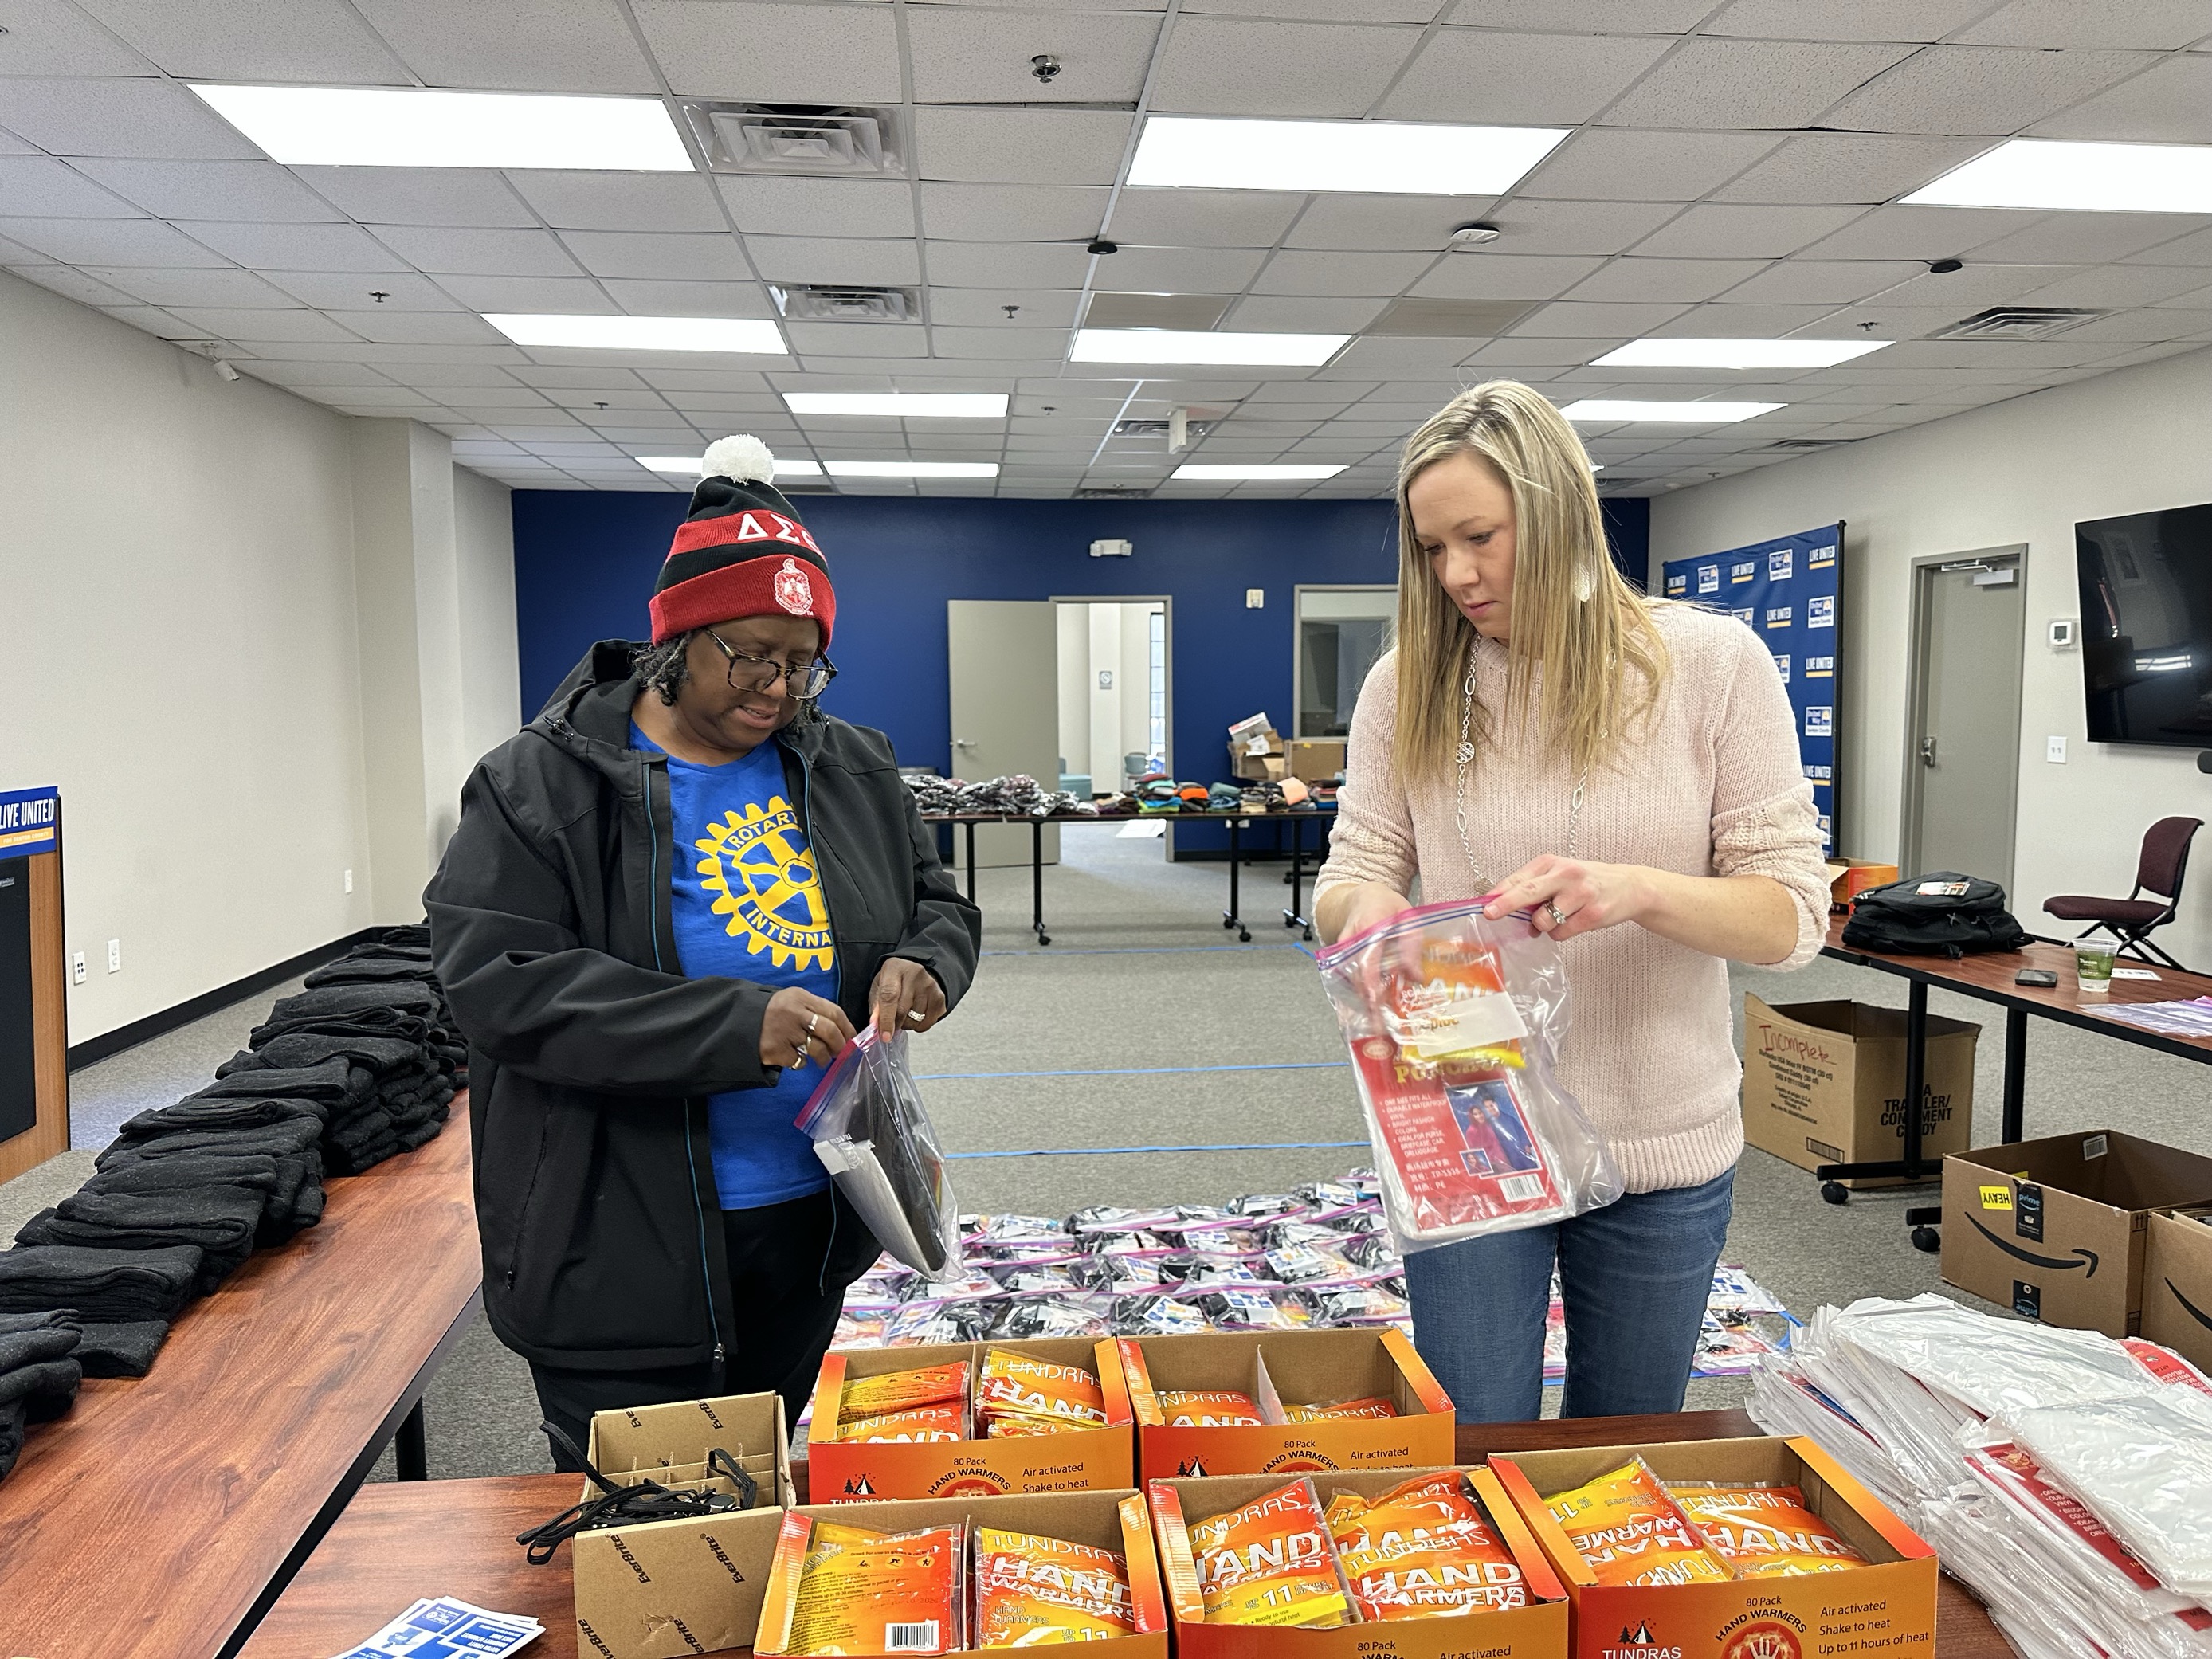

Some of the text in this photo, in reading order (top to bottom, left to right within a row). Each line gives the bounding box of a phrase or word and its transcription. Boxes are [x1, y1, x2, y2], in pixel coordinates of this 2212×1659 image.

[0, 798, 54, 829] LIVE UNITED
[1759, 1025, 1837, 1065] Incomplete
[1884, 1095, 1951, 1112] TRALER/
[1881, 1108, 1952, 1125] CONMENT
[1896, 1123, 1936, 1138] CDY
[1983, 1193, 2010, 1204] HEAVY
[2019, 1194, 2040, 1206] prime
[1285, 1405, 1390, 1424] UNDRAS
[1259, 1450, 1339, 1473] HAND WARMERS
[1350, 1447, 1409, 1460] Air activated
[1022, 1462, 1084, 1477] Air activated
[928, 1468, 1012, 1495] HAND WARMERS
[1022, 1479, 1089, 1493] Shake to heat
[1190, 1492, 1302, 1545] UNDRAS
[1571, 1516, 1685, 1550] WARME
[611, 1535, 651, 1583] EverBrite
[705, 1535, 745, 1583] EverBrite
[1200, 1557, 1322, 1595] ARMERS
[1360, 1563, 1522, 1597] HAND
[1262, 1585, 1293, 1607] 11
[1746, 1595, 1782, 1606] 80 Pack
[1288, 1612, 1300, 1621] heat
[1820, 1599, 1887, 1618] Air activated
[1255, 1614, 1272, 1623] Ready
[1715, 1609, 1807, 1641] HAND WARMERS
[1819, 1618, 1891, 1636] Shake to heat
[1357, 1640, 1396, 1651] 80 Pack
[1458, 1645, 1511, 1659] activated
[1818, 1631, 1929, 1656] Up to 11 hours of heat
[1602, 1647, 1681, 1659] TUNDRAS
